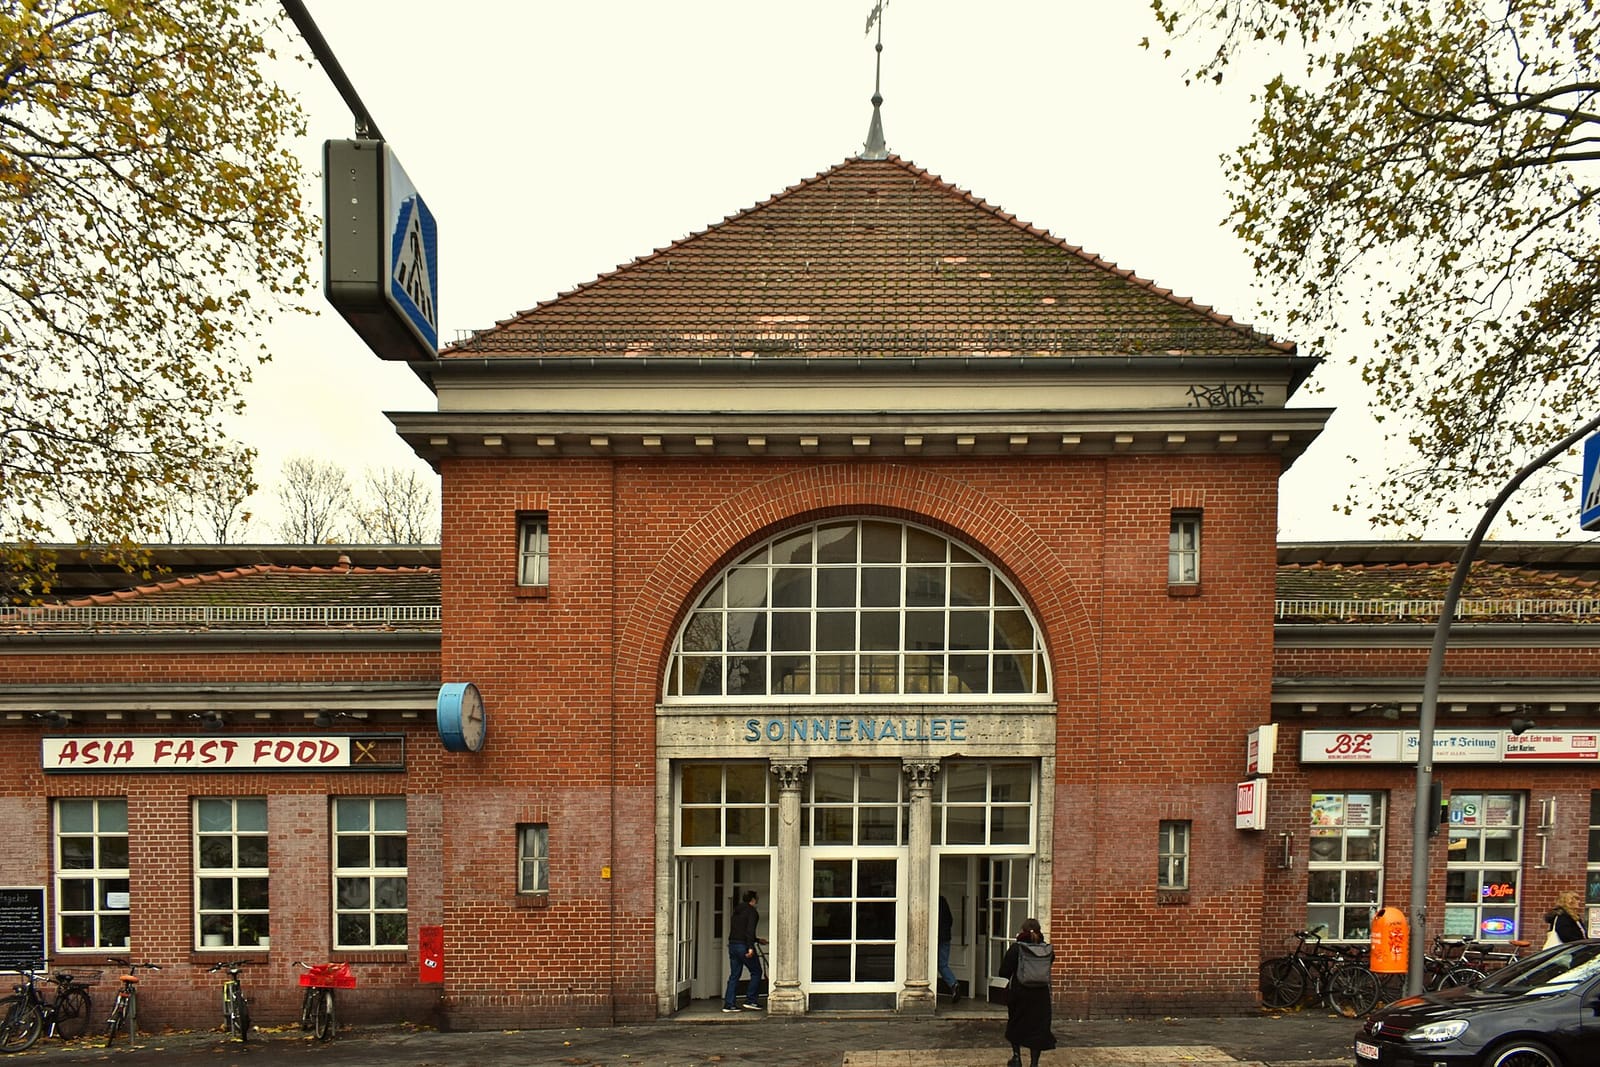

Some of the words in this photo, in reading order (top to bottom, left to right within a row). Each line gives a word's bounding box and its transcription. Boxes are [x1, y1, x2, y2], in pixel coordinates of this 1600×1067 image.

[745, 719, 967, 742] SONNENALLEE
[1458, 736, 1496, 749] Zeitung
[58, 740, 135, 765] ASIA
[153, 740, 239, 765] FAST
[253, 740, 340, 765] FOOD
[1239, 786, 1253, 812] Bild
[1452, 810, 1462, 822] U
[1489, 884, 1514, 897] Coffee
